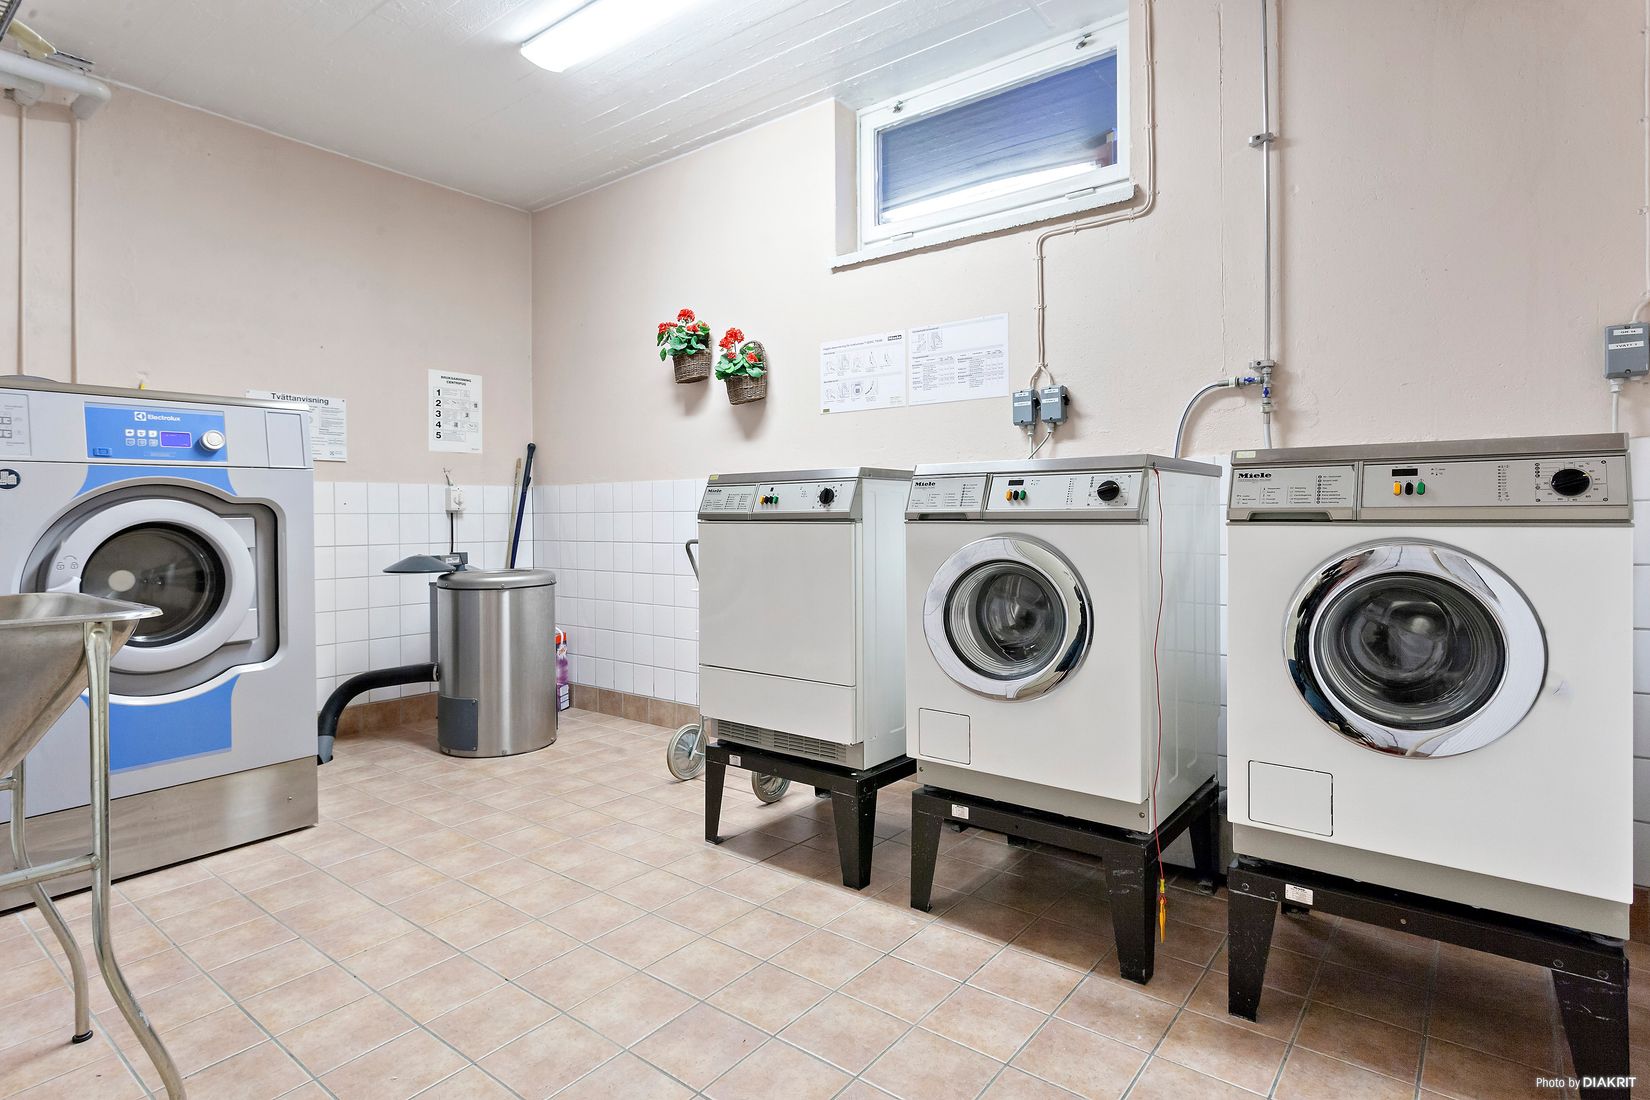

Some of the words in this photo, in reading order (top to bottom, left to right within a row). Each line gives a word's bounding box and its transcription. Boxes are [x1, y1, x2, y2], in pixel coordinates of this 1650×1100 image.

[436, 388, 442, 396] 1
[271, 392, 329, 405] Tvättanvisning
[435, 399, 442, 407] 2
[435, 410, 442, 418] 3
[435, 421, 442, 429] 4
[435, 431, 442, 439] 5
